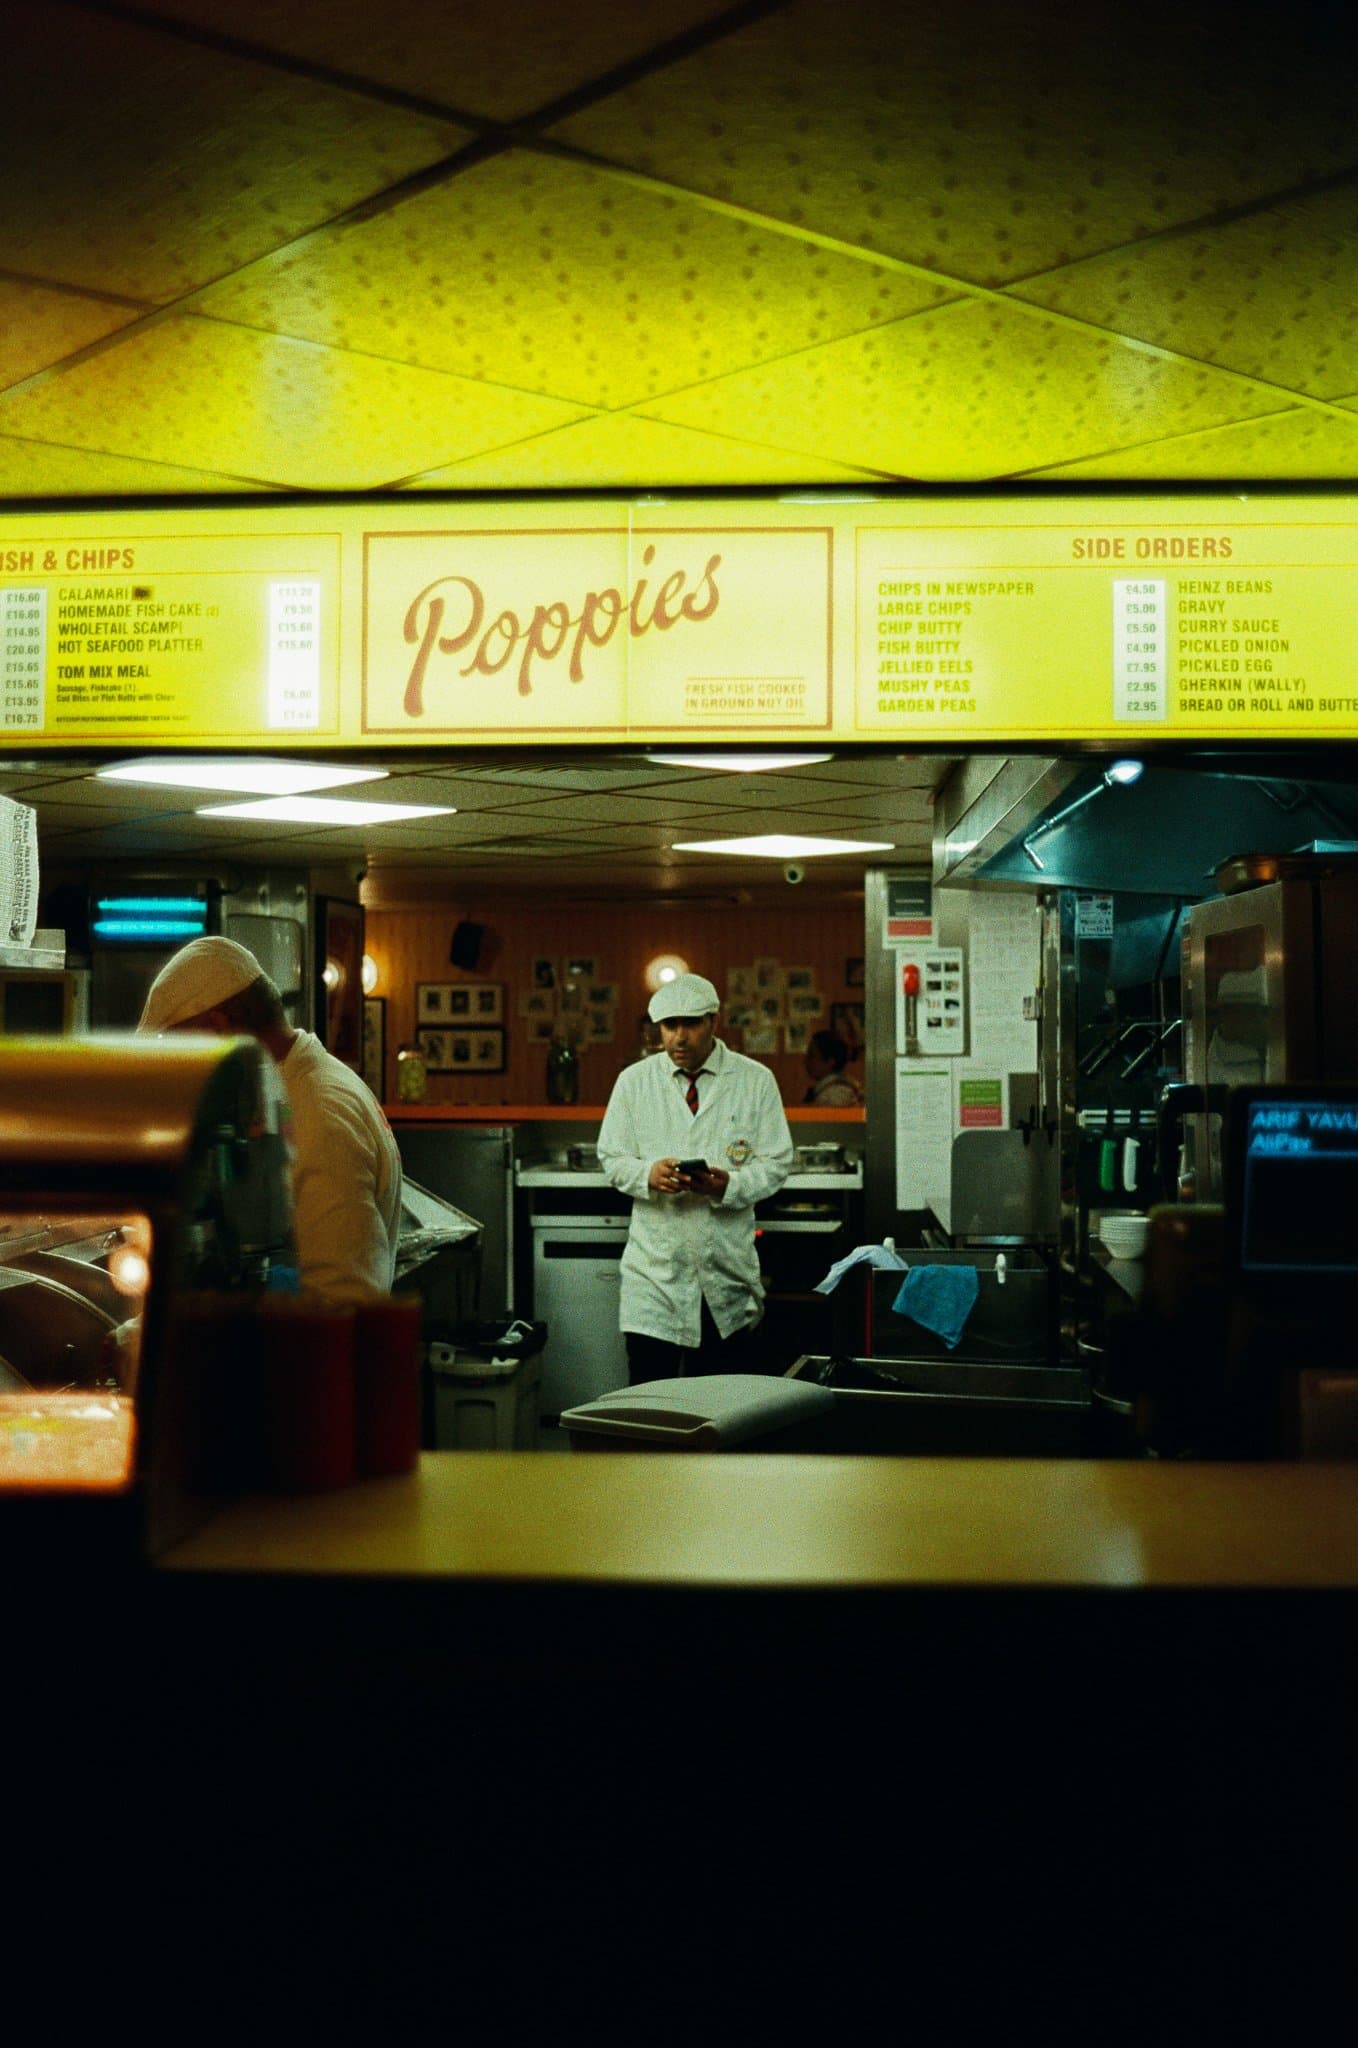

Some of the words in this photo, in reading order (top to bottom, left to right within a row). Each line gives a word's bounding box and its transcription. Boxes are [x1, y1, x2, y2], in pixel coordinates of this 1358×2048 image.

[1072, 538, 1125, 559] SIDE
[1136, 537, 1233, 558] ORDERS
[43, 550, 57, 571] &
[66, 548, 135, 570] CHIPS
[878, 582, 921, 595] CHIPS
[927, 582, 941, 595] IN
[946, 582, 1034, 595] NEWSPAPER
[1126, 584, 1156, 595] £4.50
[1178, 581, 1220, 593] HEINZ
[1226, 581, 1272, 593] BEANS
[59, 588, 128, 601] CALAMARI
[59, 605, 132, 619] HOMEMADE
[137, 604, 165, 617] FISH
[169, 604, 202, 616] CAKE
[206, 606, 220, 618] (2)
[878, 602, 923, 615] LARGE
[928, 602, 972, 615] CHIPS
[1178, 600, 1225, 613] GRAVY
[59, 621, 128, 636] WHOLETAIL
[133, 621, 183, 634] SCAMPI
[403, 545, 721, 718] Poppies
[878, 621, 912, 634] CHIP
[918, 621, 962, 634] BUTTY
[1178, 620, 1227, 633] CURRY
[1232, 620, 1280, 632] SAUCE
[58, 640, 82, 654] HOT
[86, 639, 144, 653] SEAFOOD
[148, 639, 203, 652] PLATTER
[878, 641, 910, 654] FISH
[916, 641, 960, 654] BUTTY
[1179, 640, 1239, 652] PICKLED
[1245, 640, 1289, 652] ONION
[57, 666, 85, 678] TOM
[89, 665, 113, 678] MIX
[117, 665, 151, 677] MEAL
[878, 660, 933, 673] JELLIED
[939, 660, 973, 673] EELS
[1179, 659, 1239, 672] PICKLED
[1245, 659, 1272, 672] EGG
[686, 684, 724, 694] FRESH
[728, 684, 754, 694] FISH
[758, 684, 806, 694] COOKED
[878, 680, 929, 692] MUSHY
[934, 680, 970, 692] PEAS
[1179, 679, 1242, 691] GHERKIN
[1248, 678, 1306, 693] (WALLY)
[686, 698, 697, 709] IN
[701, 698, 754, 709] GROUND
[758, 698, 781, 709] NUT
[786, 698, 805, 709] OIL
[878, 699, 935, 712] GARDEN
[940, 699, 976, 712] PEAS
[1179, 699, 1222, 711] BREAD
[1228, 699, 1245, 711] OR
[1250, 699, 1283, 711] ROLL
[1288, 699, 1313, 711] AND
